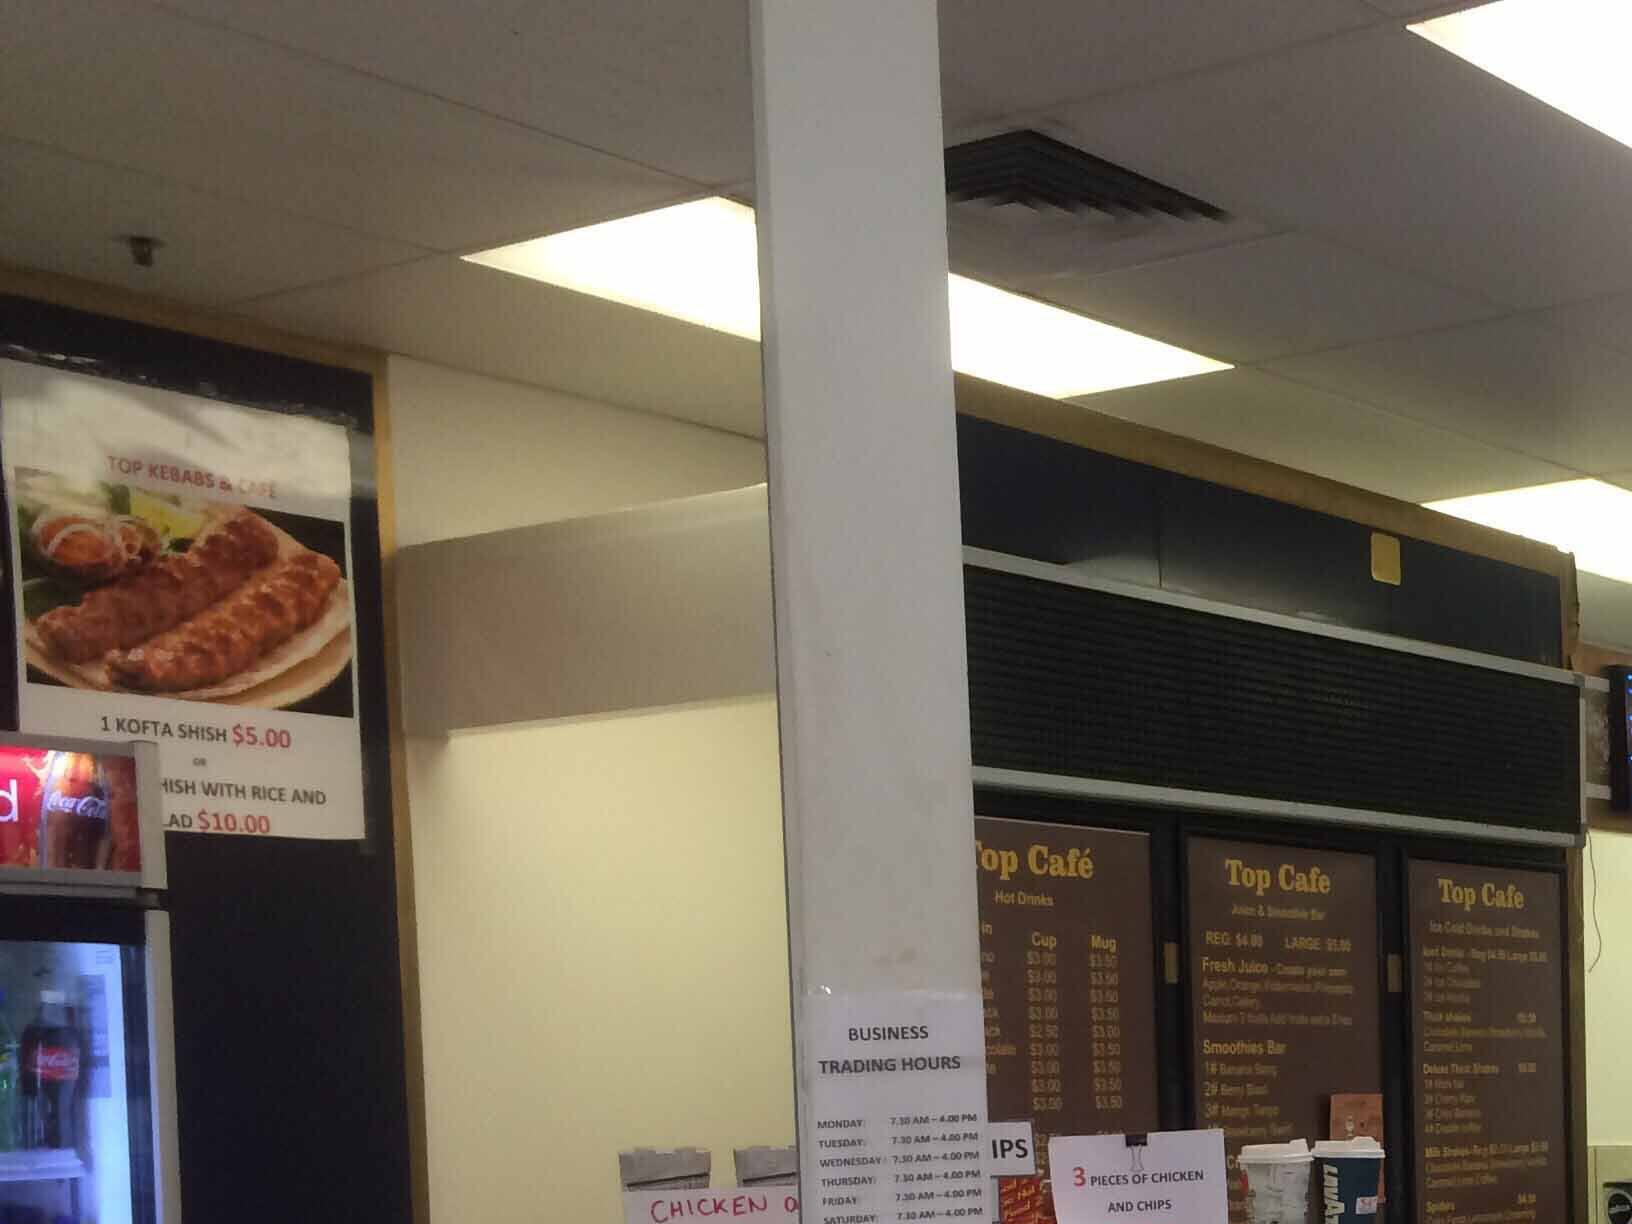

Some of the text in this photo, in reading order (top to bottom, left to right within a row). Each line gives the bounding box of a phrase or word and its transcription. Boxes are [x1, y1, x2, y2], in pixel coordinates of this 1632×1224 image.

[106, 455, 142, 475] TOP
[148, 463, 215, 489] KEBABS
[101, 716, 291, 748] 1 KOFTA SHISH $5.00
[201, 781, 246, 799] WITH
[252, 785, 287, 803] RICE
[291, 788, 327, 805] AND
[197, 808, 270, 833] $10.00
[1028, 844, 1094, 878] Café
[1225, 858, 1272, 896] Top
[995, 889, 1054, 907] Hot Drinks
[1437, 878, 1476, 912] Top
[1031, 931, 1118, 953] Cup Mug
[1202, 956, 1235, 974] Fresh
[1238, 959, 1269, 974] Juice
[848, 1025, 929, 1042] BUSINESS
[1203, 1039, 1288, 1055] Smoothies Bar
[818, 1055, 961, 1075] TRADING HOURS
[912, 1115, 930, 1125] AM
[961, 1113, 978, 1122] PM
[914, 1135, 930, 1143] AM
[963, 1132, 979, 1141] PM
[915, 1154, 932, 1162] AM
[964, 1151, 980, 1160] PM
[992, 1138, 1028, 1159] IPS
[916, 1172, 933, 1181] AM
[965, 1169, 981, 1179] PM
[1073, 1166, 1204, 1187] 3 PIECES OF CHICKEN
[918, 1191, 934, 1200] AM
[966, 1188, 982, 1197] PM
[650, 1194, 768, 1223] CHICKEN
[919, 1210, 935, 1219] AM
[967, 1207, 983, 1216] PM
[1108, 1199, 1172, 1213] AND CHIPS
